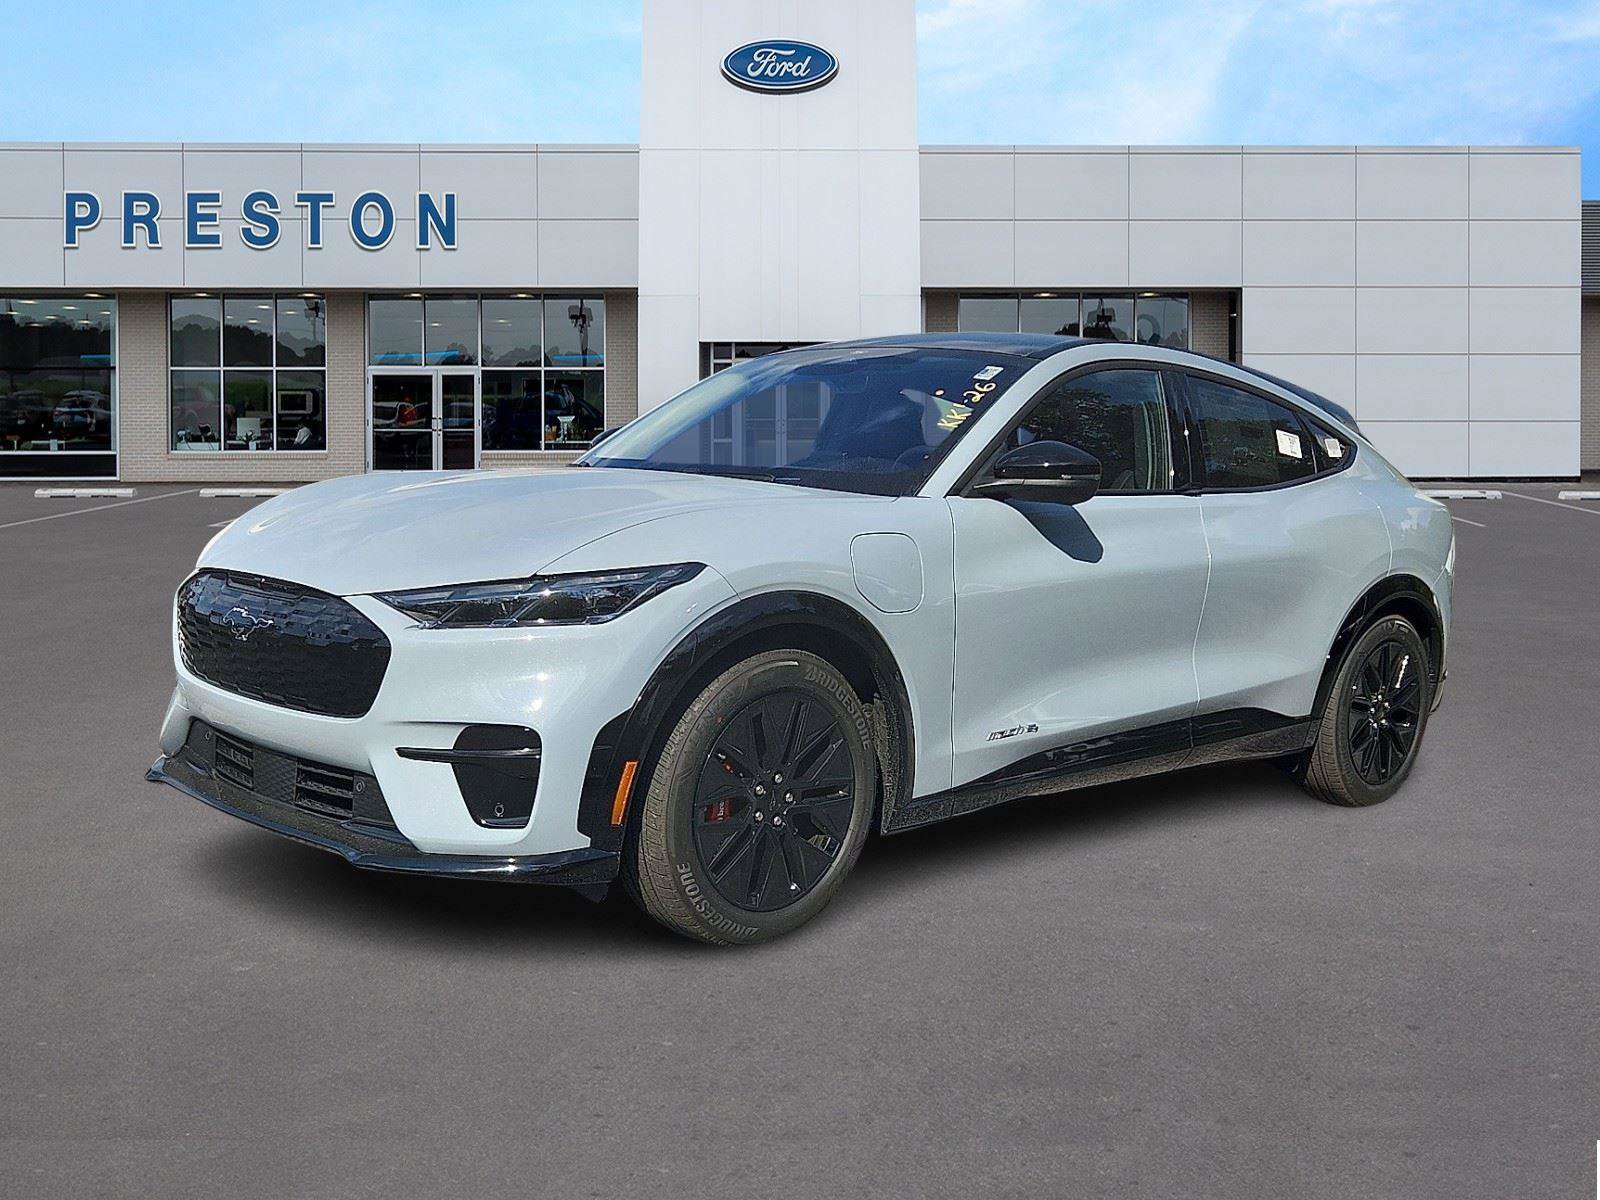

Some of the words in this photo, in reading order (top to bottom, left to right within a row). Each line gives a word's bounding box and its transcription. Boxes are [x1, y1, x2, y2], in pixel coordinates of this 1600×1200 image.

[747, 48, 812, 77] Ford
[63, 190, 458, 251] PRESTON
[804, 663, 871, 751] BRIDGESTONE
[676, 862, 760, 939] BRIDGESTONE
